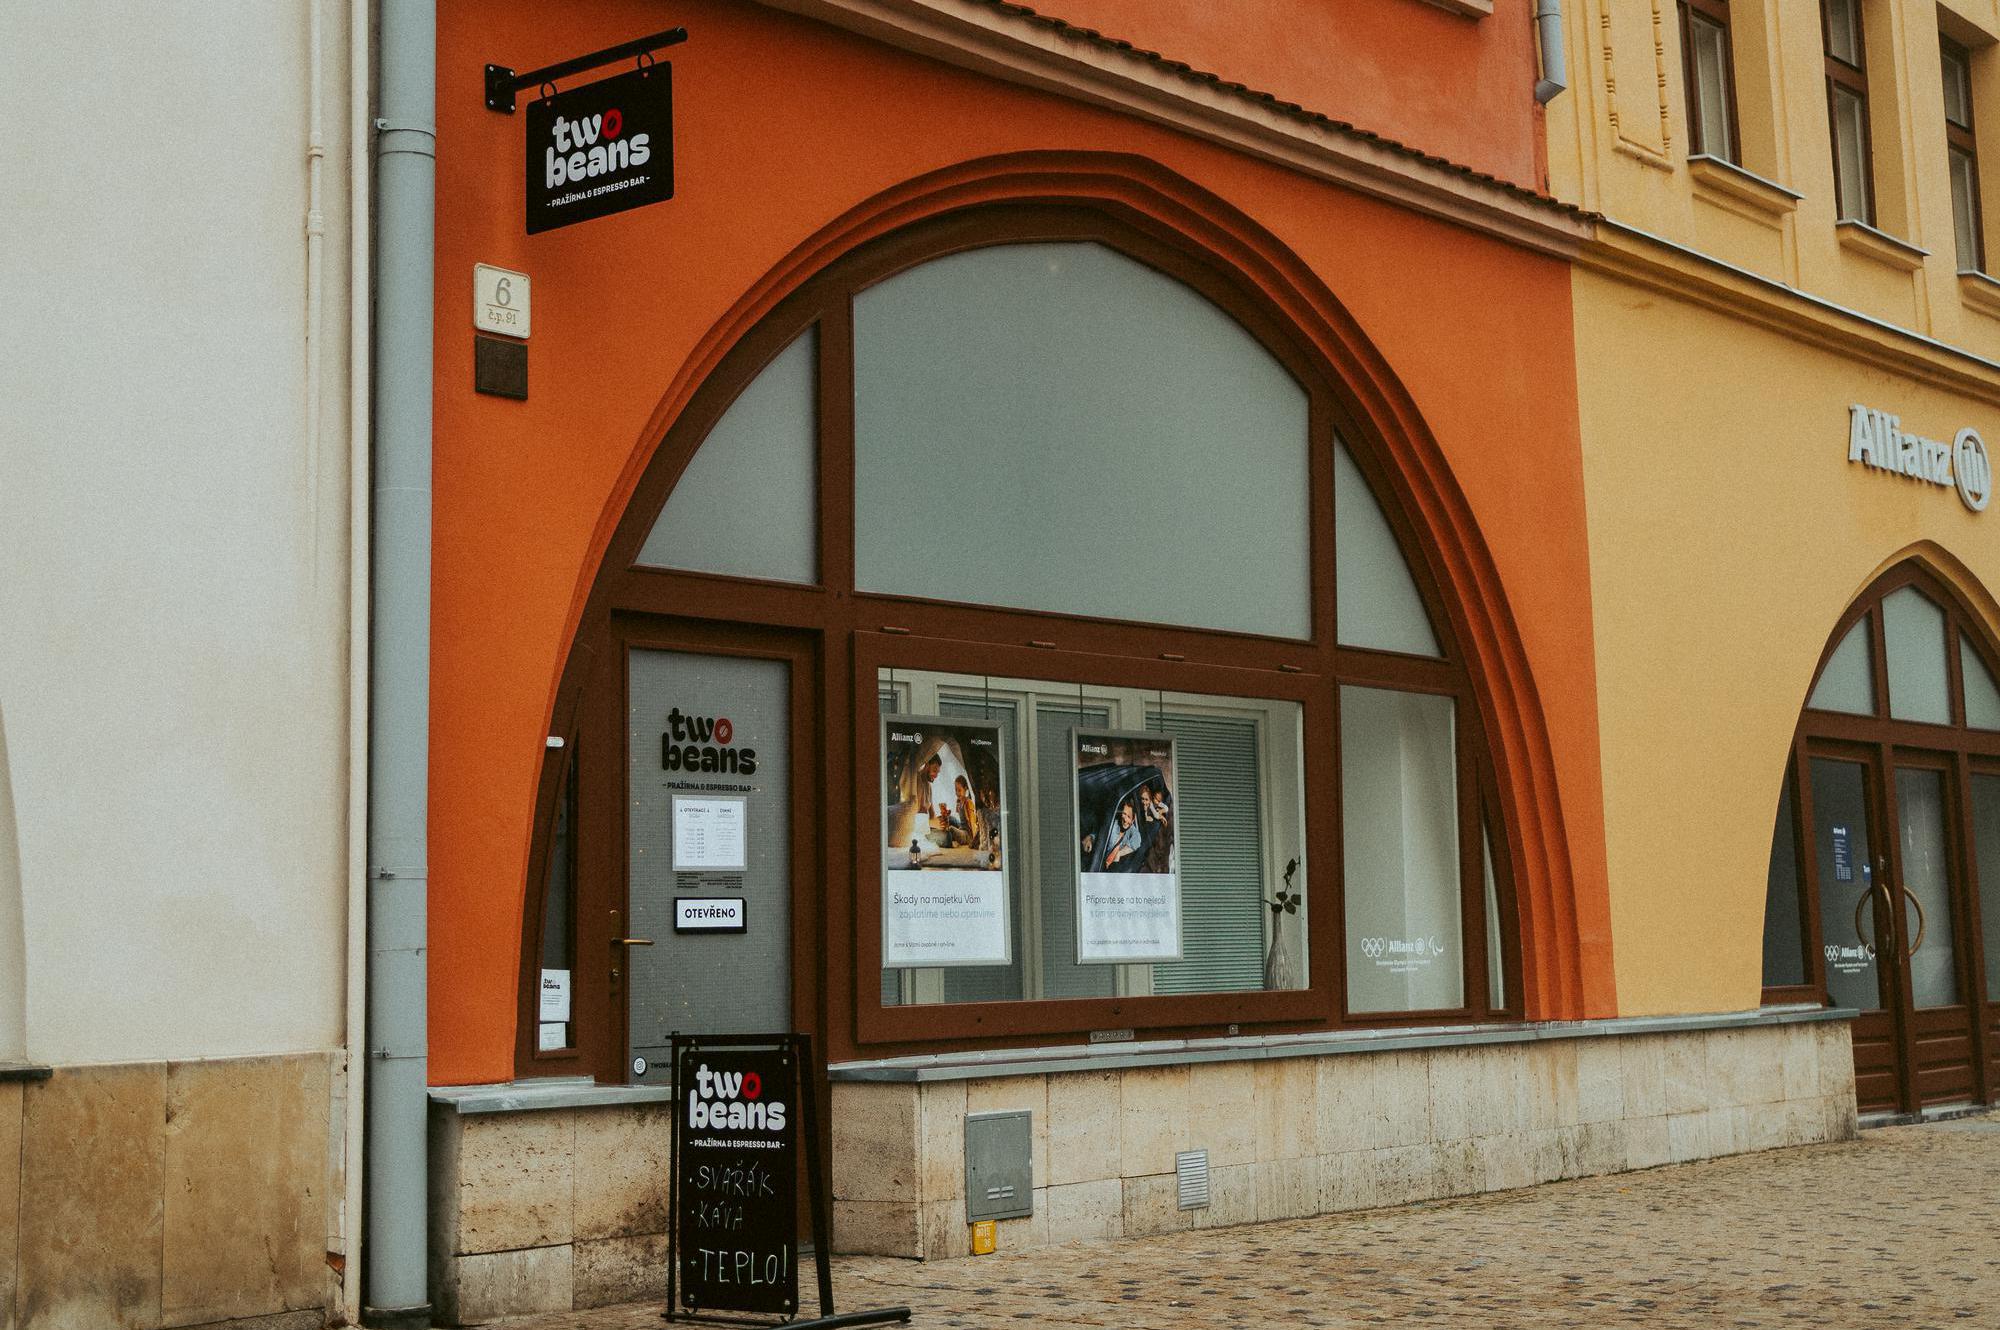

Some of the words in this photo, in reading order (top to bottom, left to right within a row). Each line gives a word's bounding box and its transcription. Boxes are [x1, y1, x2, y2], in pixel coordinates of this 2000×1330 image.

[552, 108, 623, 153] two
[546, 133, 650, 189] beans
[551, 191, 586, 207] PRAŽÍRNA
[587, 188, 593, 198] &
[593, 180, 629, 197] ESPRESSO
[630, 175, 645, 187] BAR
[496, 277, 511, 306] 6
[1849, 403, 1955, 488] Allianz
[668, 707, 733, 744] two
[891, 732, 914, 742] Allianz
[661, 732, 757, 775] beans
[1081, 744, 1101, 753] Allianz
[667, 781, 699, 790] PRAŽÍRNA
[706, 783, 738, 792] ESPRESSO
[684, 905, 736, 918] OTEVŘENO
[920, 896, 931, 904] na
[932, 894, 963, 905] majetku
[1389, 940, 1414, 952] Allianz
[696, 1063, 762, 1099] two
[689, 1089, 786, 1131] beans
[694, 1138, 726, 1148] PRAŽÍRNA
[727, 1140, 732, 1148] &
[733, 1140, 766, 1149] ESPRESSO
[767, 1141, 780, 1149] BAR
[699, 1244, 787, 1284] TEPLO!
